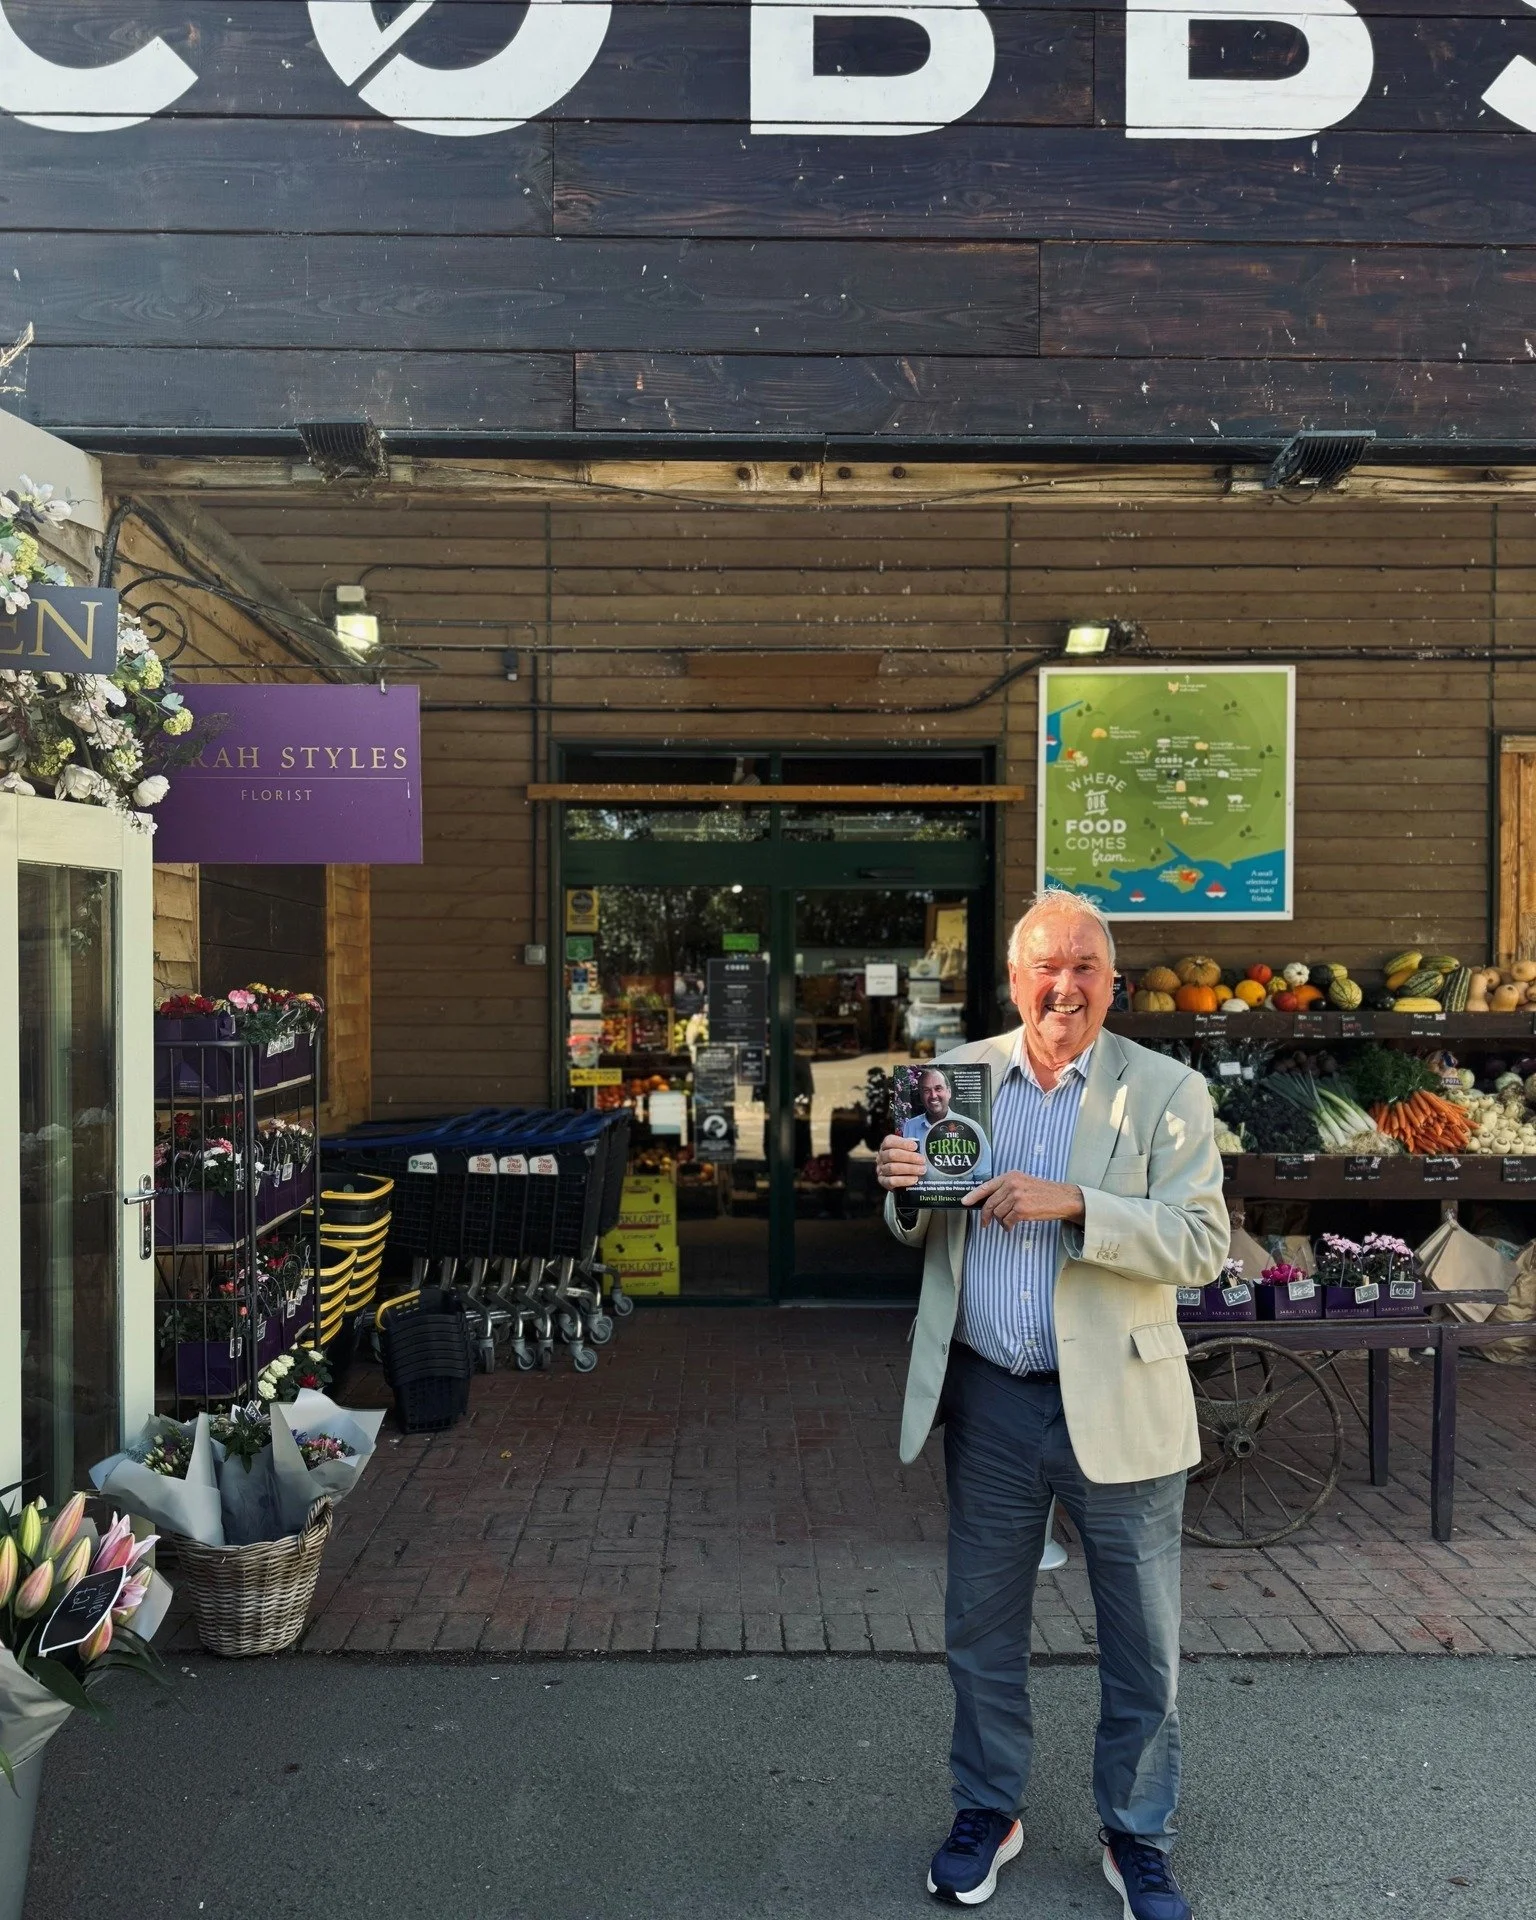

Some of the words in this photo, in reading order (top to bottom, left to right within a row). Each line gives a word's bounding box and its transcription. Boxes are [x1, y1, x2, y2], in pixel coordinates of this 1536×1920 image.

[280, 746, 408, 769] STYLES
[1066, 772, 1127, 793] WHERE
[241, 788, 313, 801] FLORIST
[1086, 792, 1107, 813] OUR
[1065, 819, 1127, 835] FOOD
[1065, 837, 1127, 851] COMES
[928, 1138, 977, 1155] FIRKIN
[934, 1154, 972, 1167] SAGA
